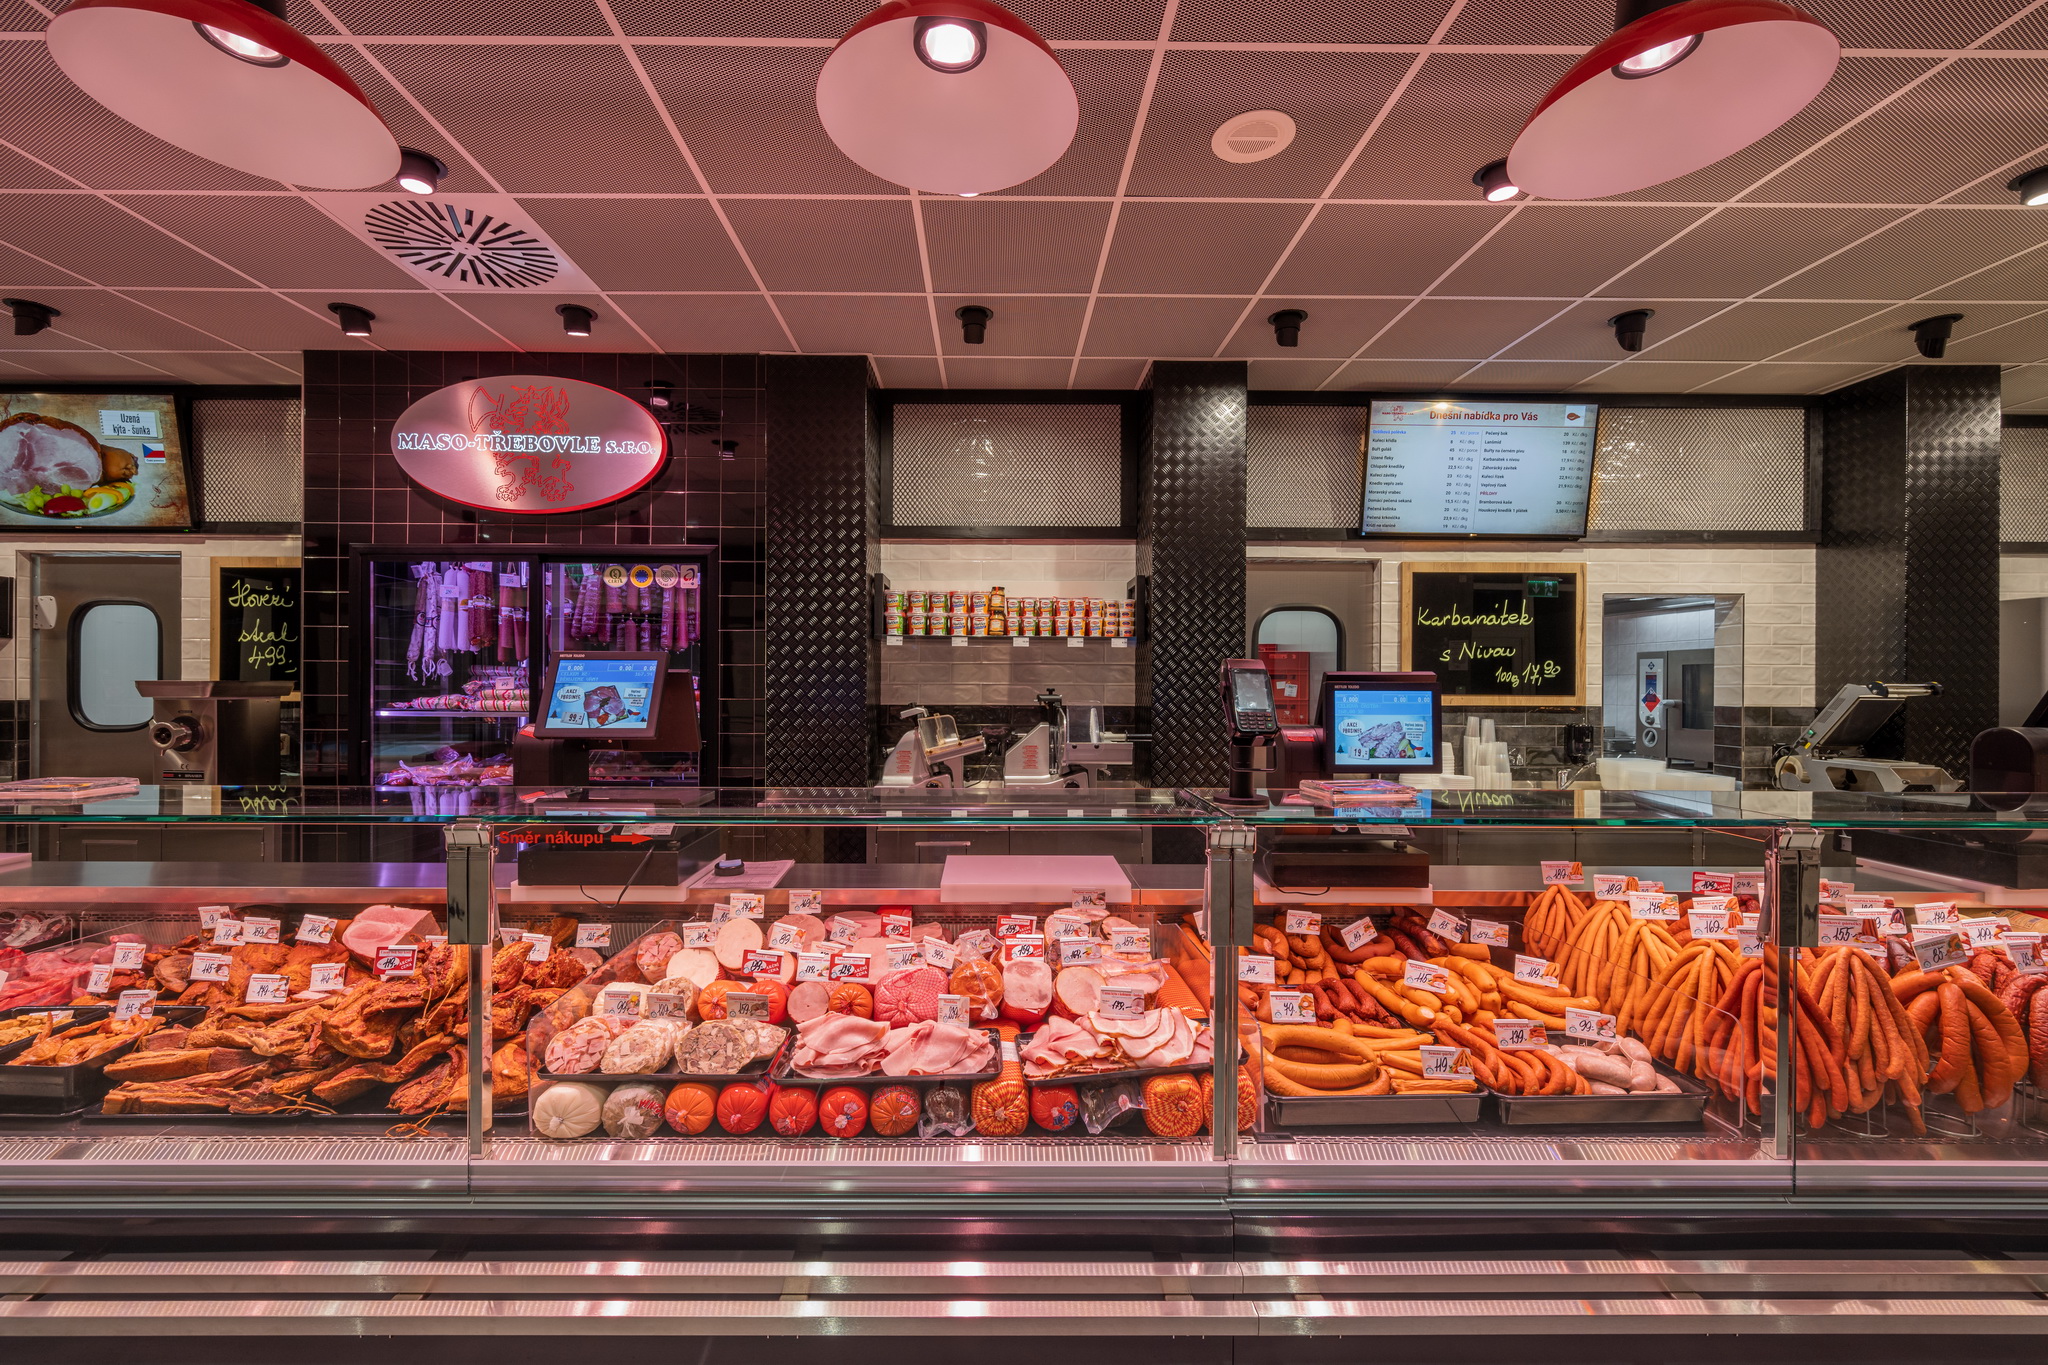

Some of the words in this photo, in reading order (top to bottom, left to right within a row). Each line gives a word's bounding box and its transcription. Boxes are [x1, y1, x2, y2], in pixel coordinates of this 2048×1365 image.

[120, 414, 140, 423] Uzená
[1430, 410, 1462, 420] Dnešní
[1464, 411, 1500, 420] nabídka
[1503, 413, 1518, 422] pro
[1521, 412, 1538, 421] Vás
[113, 424, 126, 436] kýta
[132, 425, 150, 435] šunka
[398, 430, 600, 453] MASO-TŘEBOVLE
[605, 441, 656, 454] s.r.o.
[1417, 600, 1533, 626] Karbanátek
[1440, 649, 1450, 661] s
[1458, 641, 1516, 660] Nivou
[1495, 666, 1519, 687] 100g
[499, 830, 541, 844] Směr
[545, 831, 604, 847] nákupu
